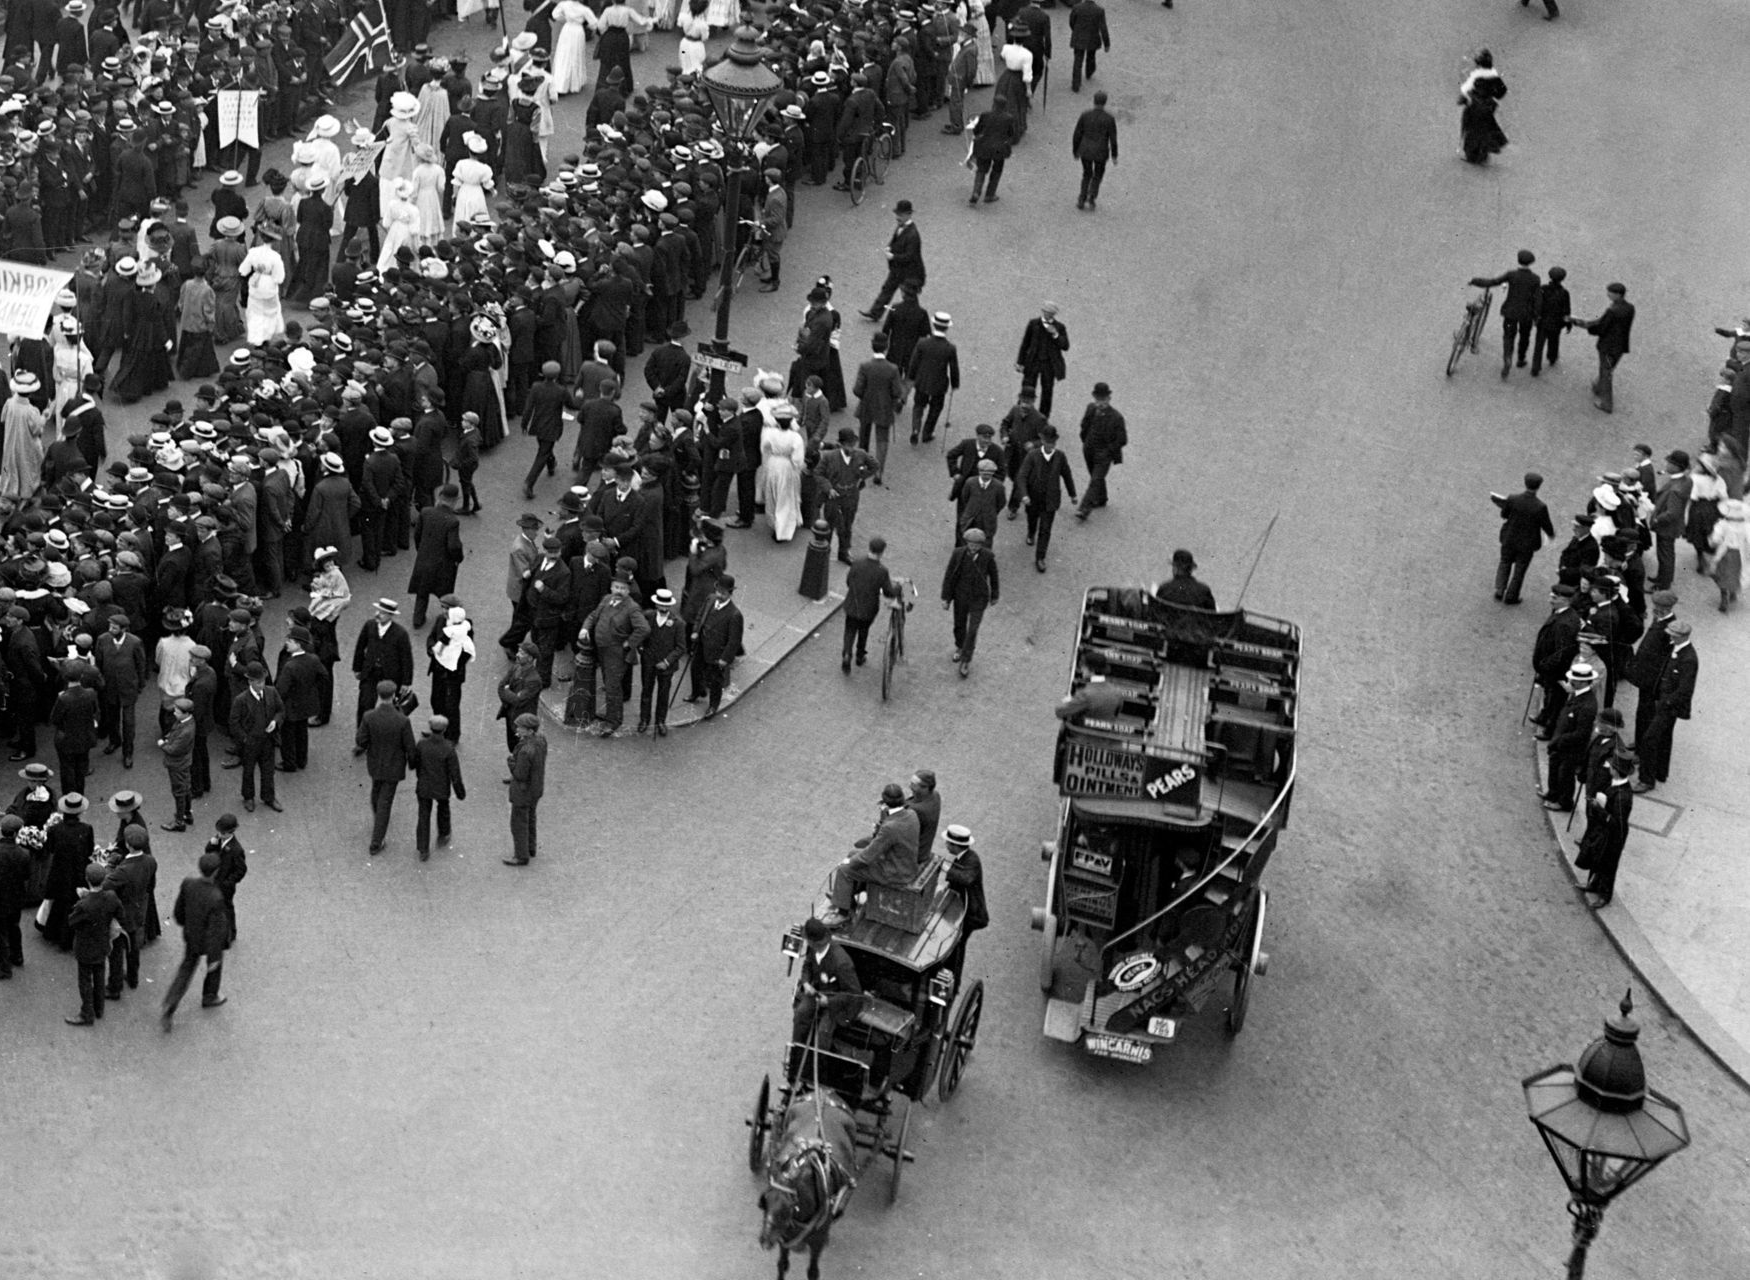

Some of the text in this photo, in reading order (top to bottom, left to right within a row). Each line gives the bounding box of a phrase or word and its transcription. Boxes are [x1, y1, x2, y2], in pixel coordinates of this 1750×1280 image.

[1069, 744, 1144, 772] HOLLOWAYS
[1066, 773, 1139, 796] OINTMENT
[1085, 765, 1129, 782] PILLS
[1146, 763, 1197, 800] PEARS
[1174, 949, 1218, 988] HEAD
[1086, 1037, 1152, 1060] WINCARNIS
